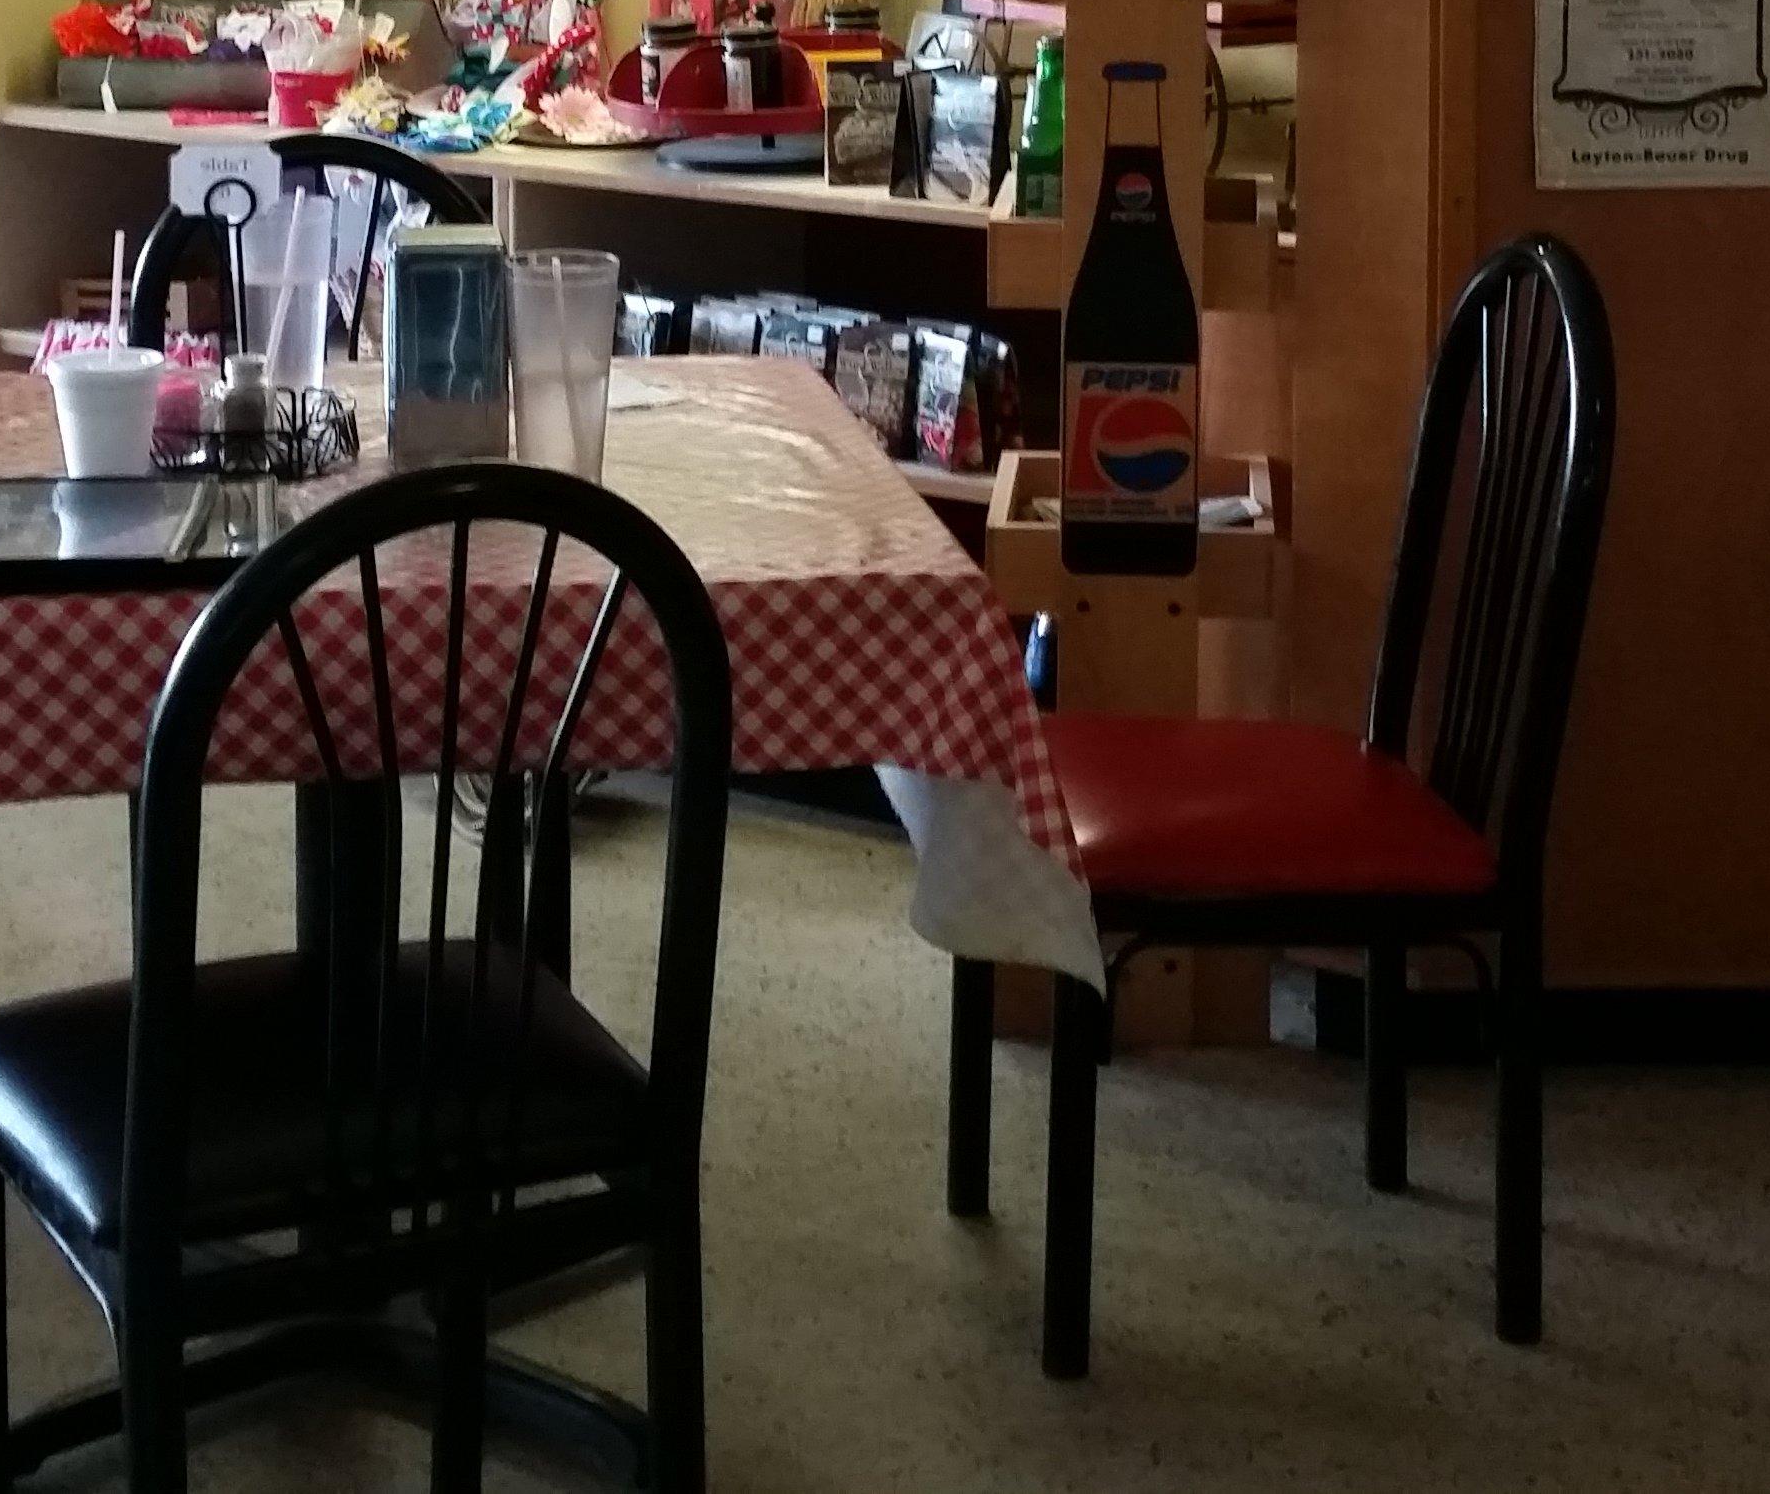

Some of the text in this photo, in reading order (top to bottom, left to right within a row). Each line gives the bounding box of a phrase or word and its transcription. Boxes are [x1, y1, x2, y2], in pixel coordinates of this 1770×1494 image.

[1703, 148, 1749, 167] Drug
[1109, 210, 1156, 224] PEPSI
[1081, 368, 1181, 393] PEPSI
